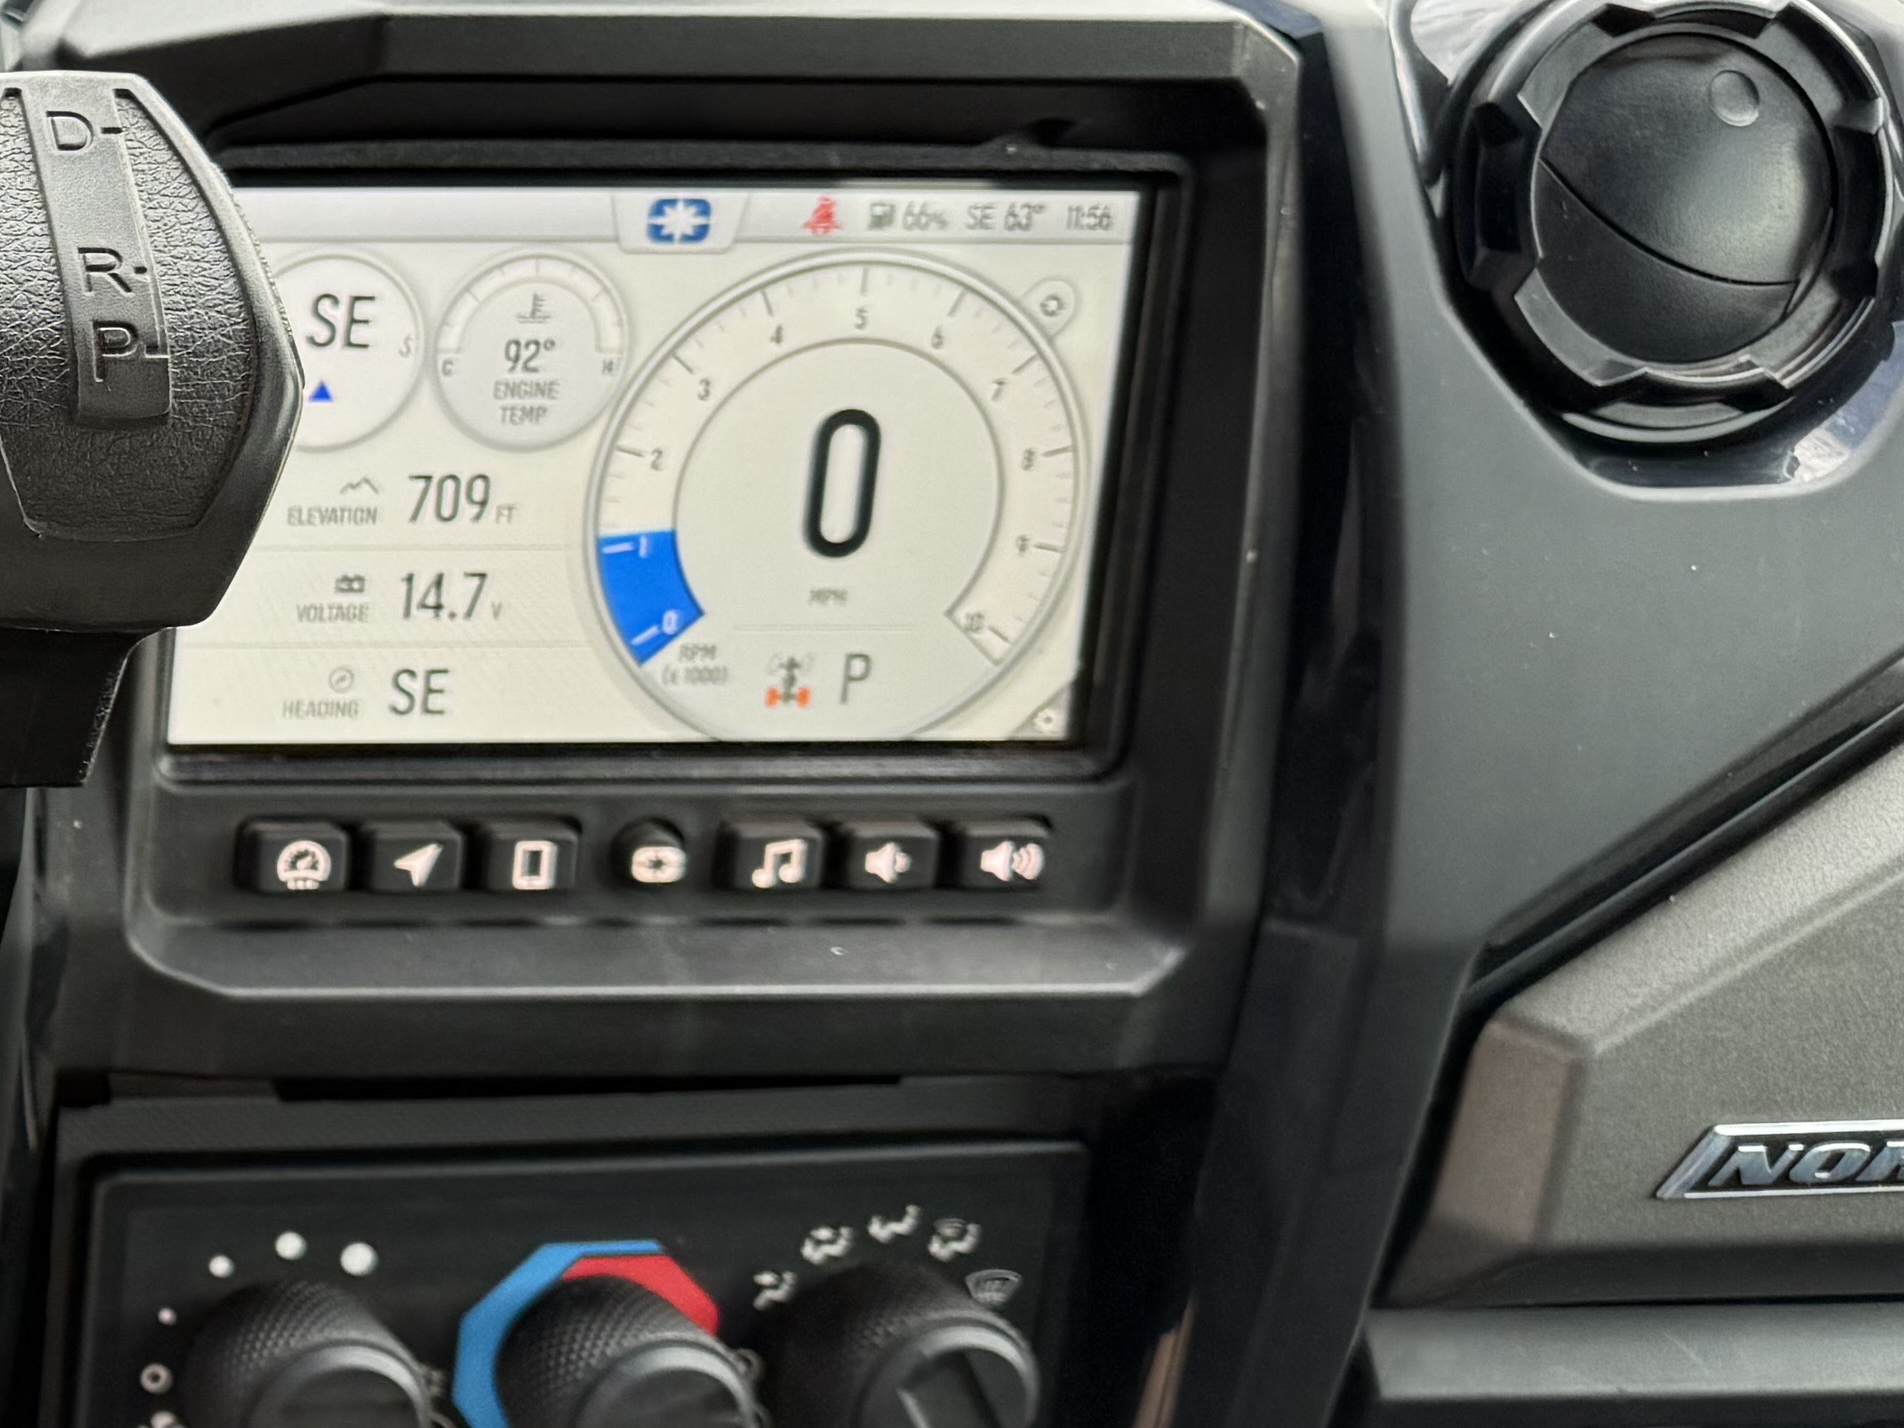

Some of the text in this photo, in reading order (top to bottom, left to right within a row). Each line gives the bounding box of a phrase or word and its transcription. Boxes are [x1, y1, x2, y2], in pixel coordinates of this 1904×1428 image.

[46, 110, 94, 152] D
[966, 204, 997, 231] SE
[1065, 203, 1114, 231] 11:56
[78, 247, 133, 297] R
[305, 292, 377, 349] SE
[853, 306, 869, 332] 5
[770, 325, 785, 347] 4
[94, 320, 140, 384] P
[493, 379, 561, 401] ENGINE
[696, 379, 712, 401] 3
[992, 378, 1007, 402] 7
[498, 404, 549, 426] TEMP
[648, 449, 664, 471] 2
[801, 408, 882, 559] 0
[286, 473, 517, 526] ELEVATION 709 FT
[295, 603, 370, 623] VOLTAGE
[399, 571, 488, 621] 14.7
[807, 589, 848, 606] MPH
[662, 610, 680, 635] 0
[677, 643, 717, 662] RPM
[840, 653, 872, 705] P
[282, 668, 449, 719] HEADING SE
